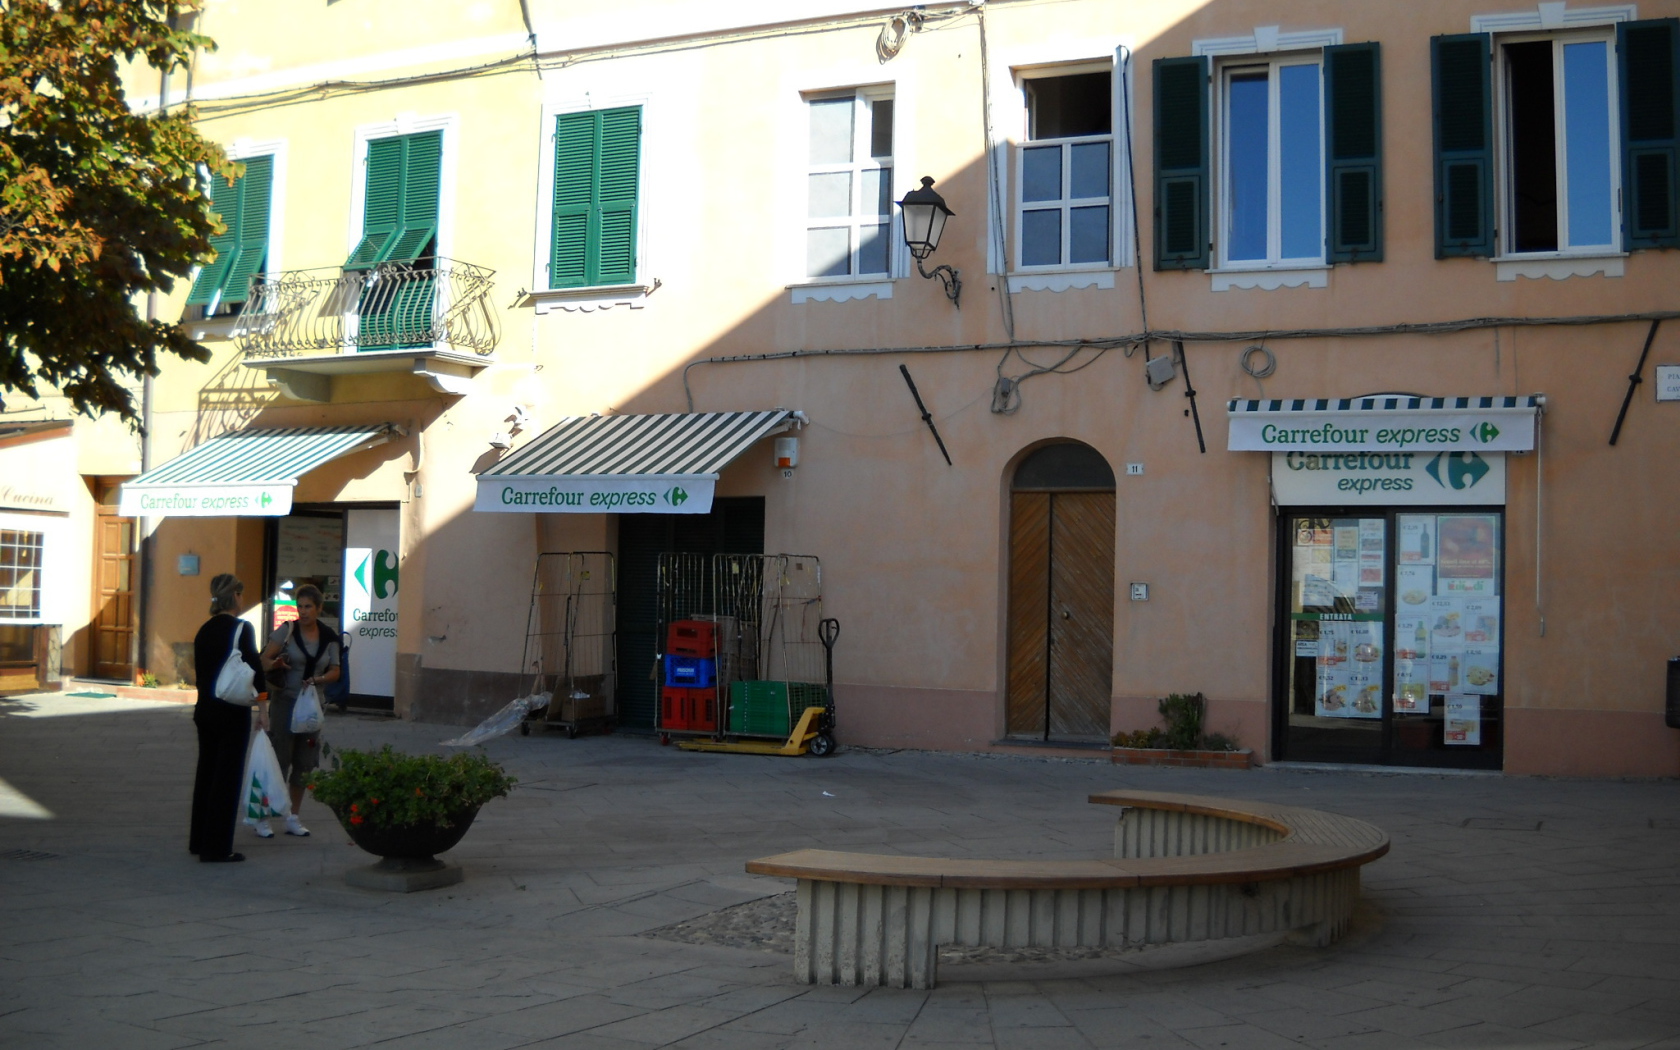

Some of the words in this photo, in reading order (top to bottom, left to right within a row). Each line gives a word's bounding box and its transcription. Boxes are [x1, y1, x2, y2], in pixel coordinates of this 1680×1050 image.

[1261, 423, 1369, 444] Carrefour
[1376, 427, 1461, 448] express
[1131, 465, 1138, 473] 11
[1287, 451, 1414, 471] Carrefour
[783, 470, 793, 478] 10
[1337, 477, 1414, 495] express
[140, 492, 198, 510] Carrefour
[201, 495, 250, 511] express
[501, 486, 584, 506] Carrefour
[589, 491, 657, 510] express
[1319, 613, 1353, 621] ENTRATA
